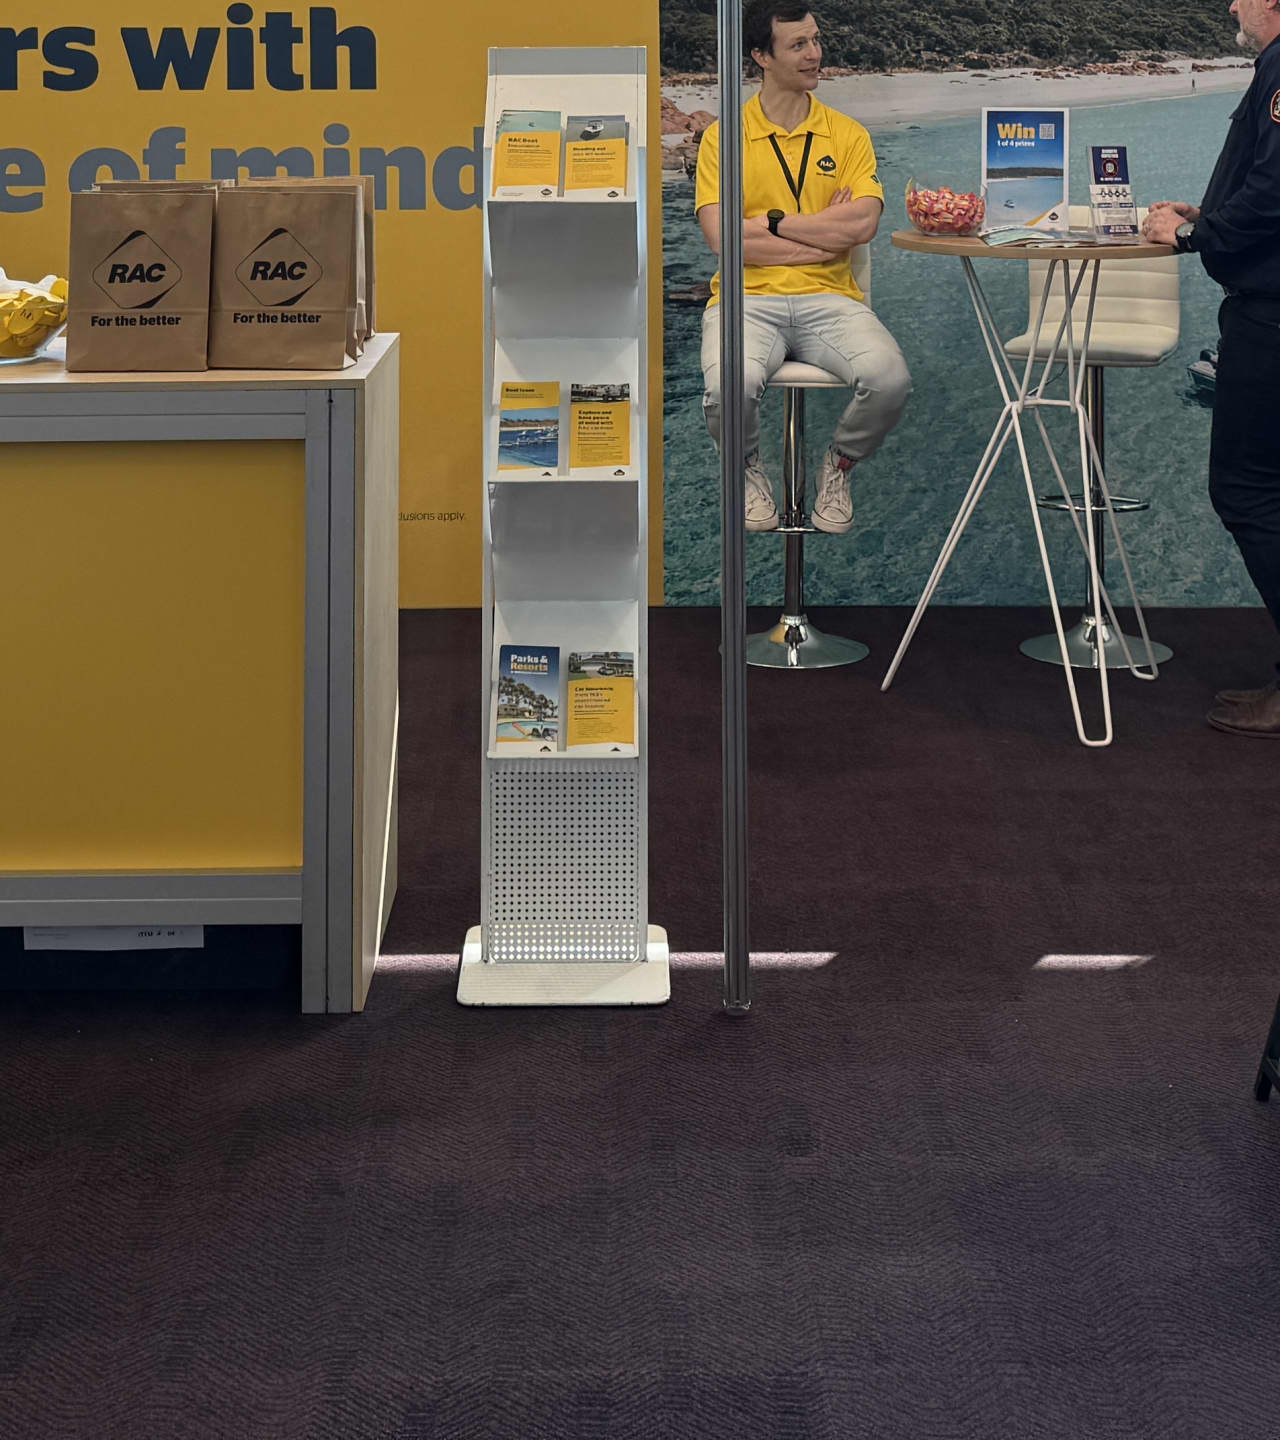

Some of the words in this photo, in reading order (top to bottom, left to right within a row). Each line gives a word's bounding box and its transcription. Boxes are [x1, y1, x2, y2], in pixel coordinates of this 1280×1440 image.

[121, 3, 378, 92] with
[997, 122, 1036, 140] Win
[68, 126, 186, 193] of
[211, 123, 485, 211] mind
[108, 262, 167, 284] RAC
[250, 260, 308, 281] RAC
[91, 315, 114, 327] For
[115, 315, 137, 327] the
[139, 314, 182, 327] better
[233, 312, 256, 324] For
[257, 312, 279, 324] the
[280, 312, 322, 324] better
[437, 512, 465, 522] apply
[511, 654, 539, 663] Parks
[540, 655, 548, 664] &
[511, 663, 548, 671] Resorts
